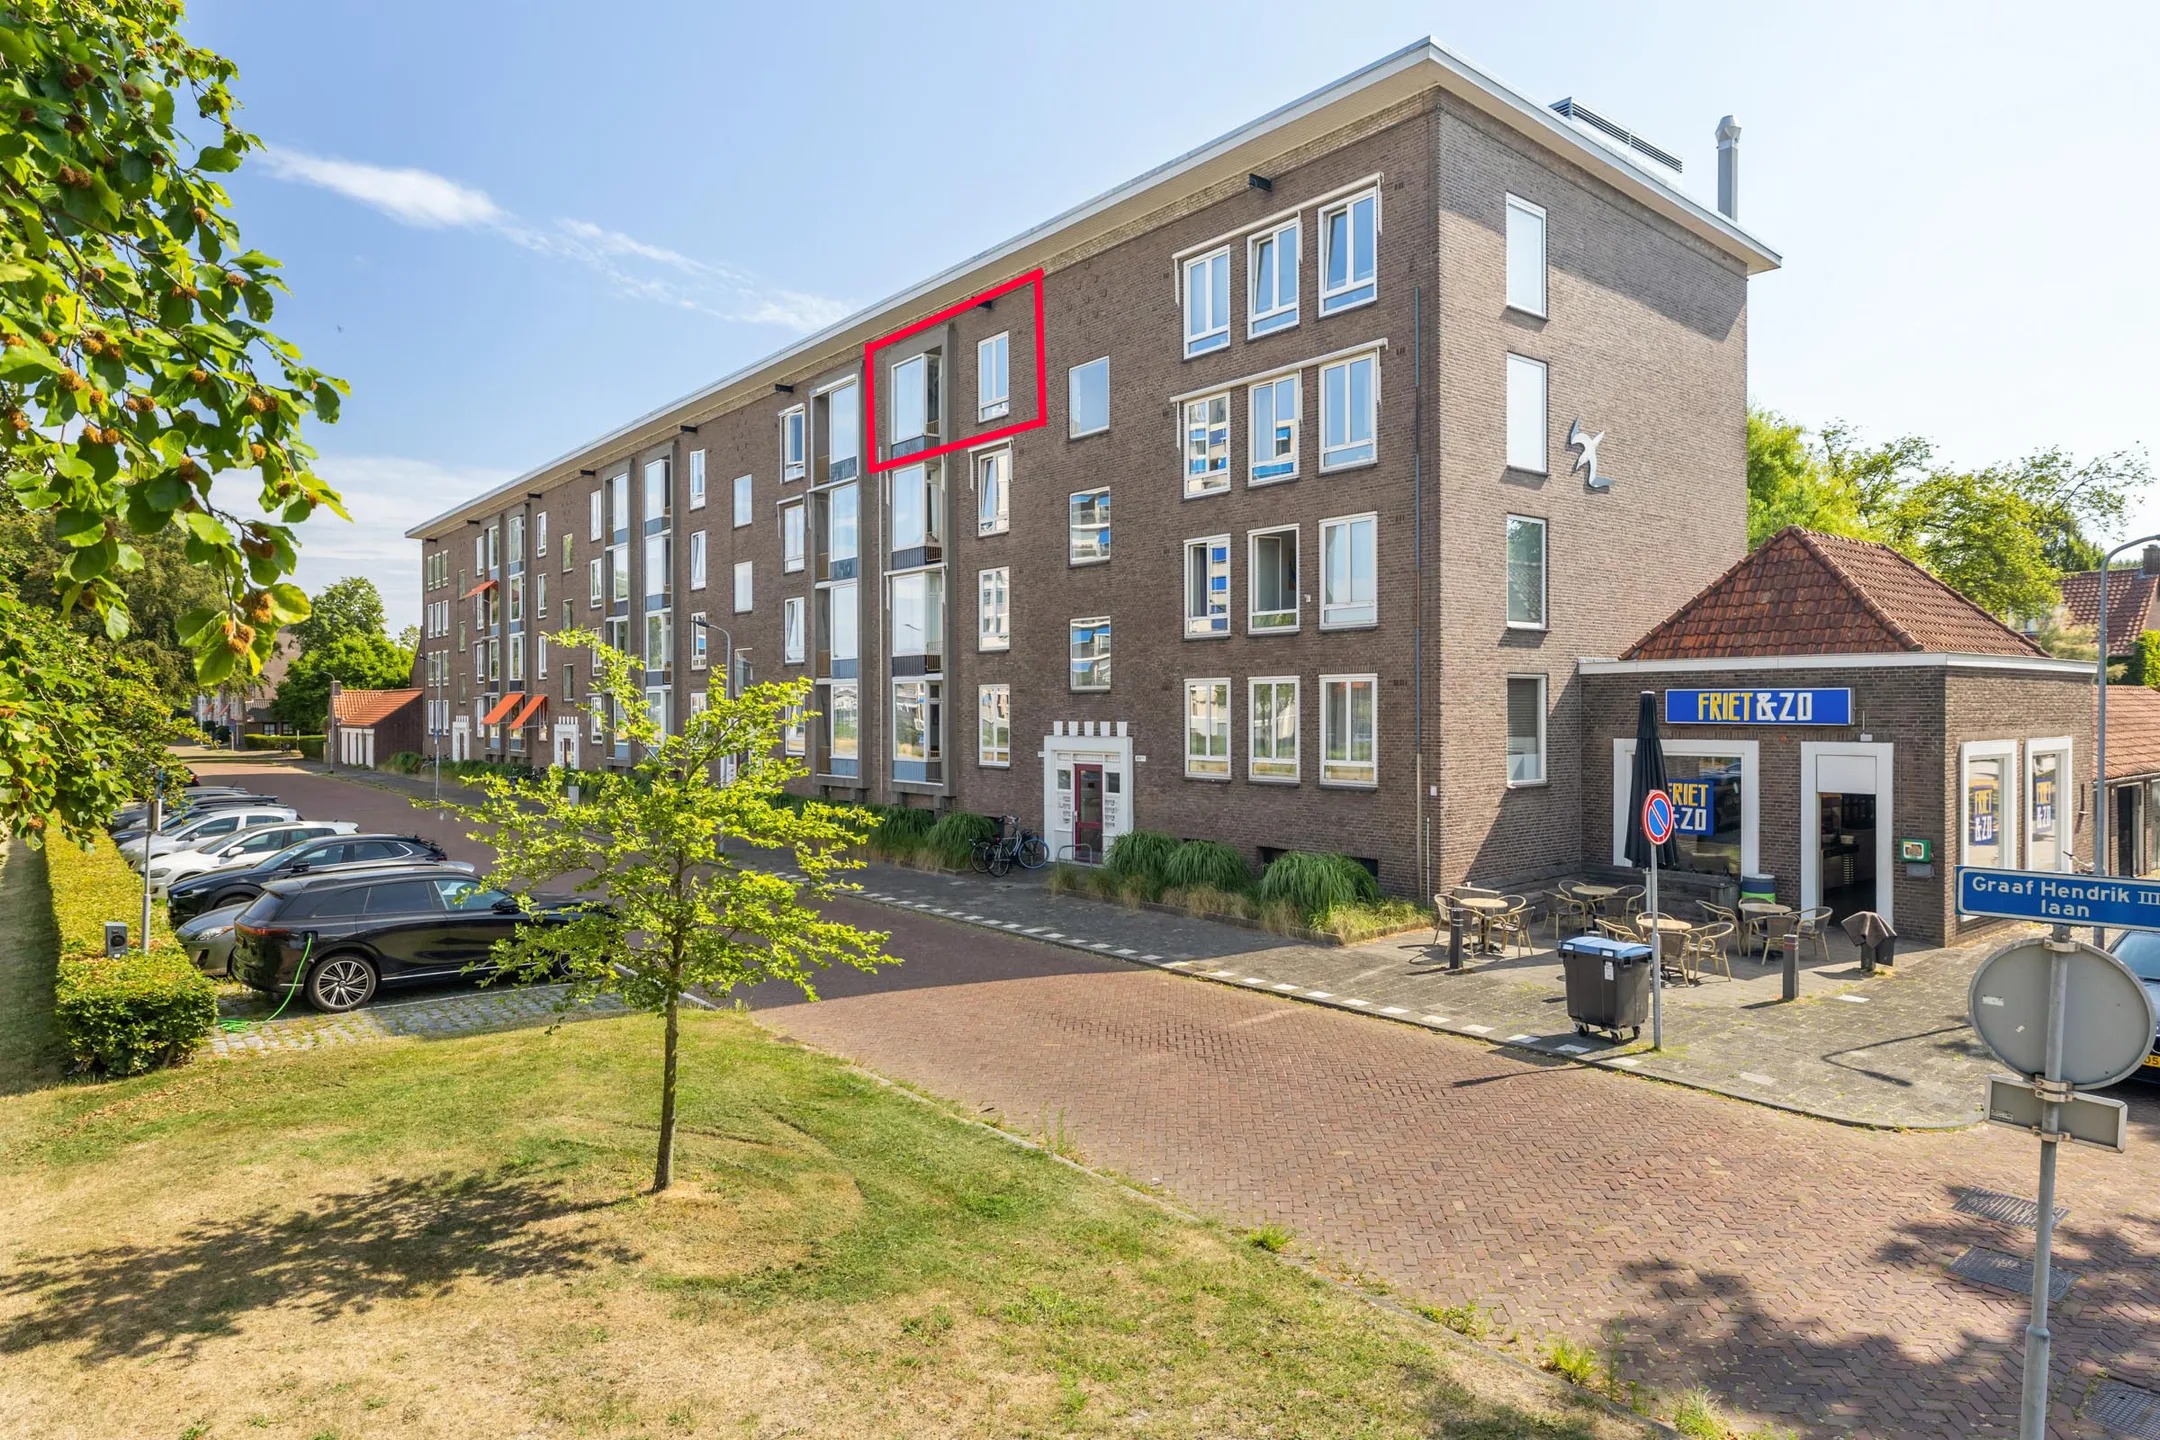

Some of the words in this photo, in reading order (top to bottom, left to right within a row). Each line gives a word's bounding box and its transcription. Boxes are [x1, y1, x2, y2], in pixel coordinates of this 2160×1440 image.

[1698, 692, 1753, 721] FRIET
[1972, 876, 2034, 895] Graaf
[2040, 881, 2130, 904] Hendrik
[2040, 899, 2090, 917] laan
